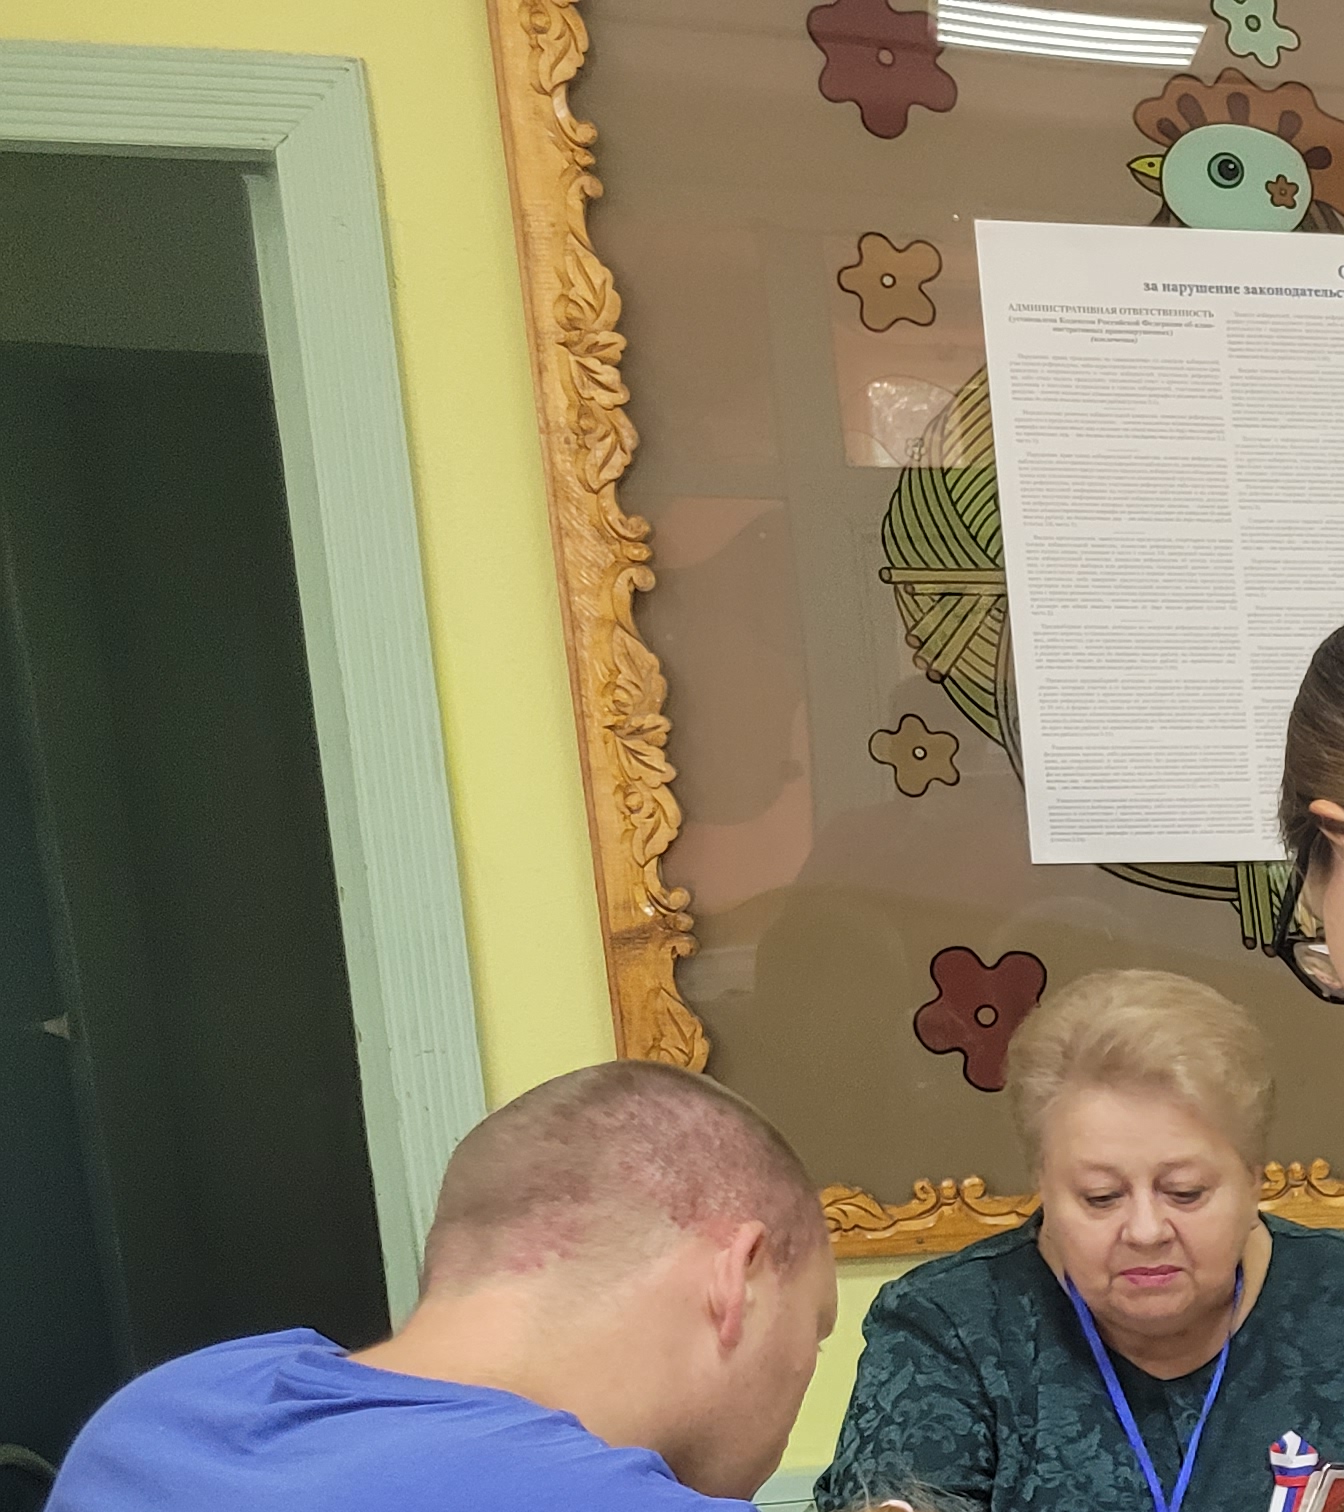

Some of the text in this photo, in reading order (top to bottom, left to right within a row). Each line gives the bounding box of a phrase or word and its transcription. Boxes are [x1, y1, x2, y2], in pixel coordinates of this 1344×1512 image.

[1144, 282, 1158, 292] за
[1162, 283, 1240, 297] нарушение
[1008, 303, 1215, 319] АДМИНИСТРАТИВНАЯ ОТВЕТСТВЕННОСТЬ
